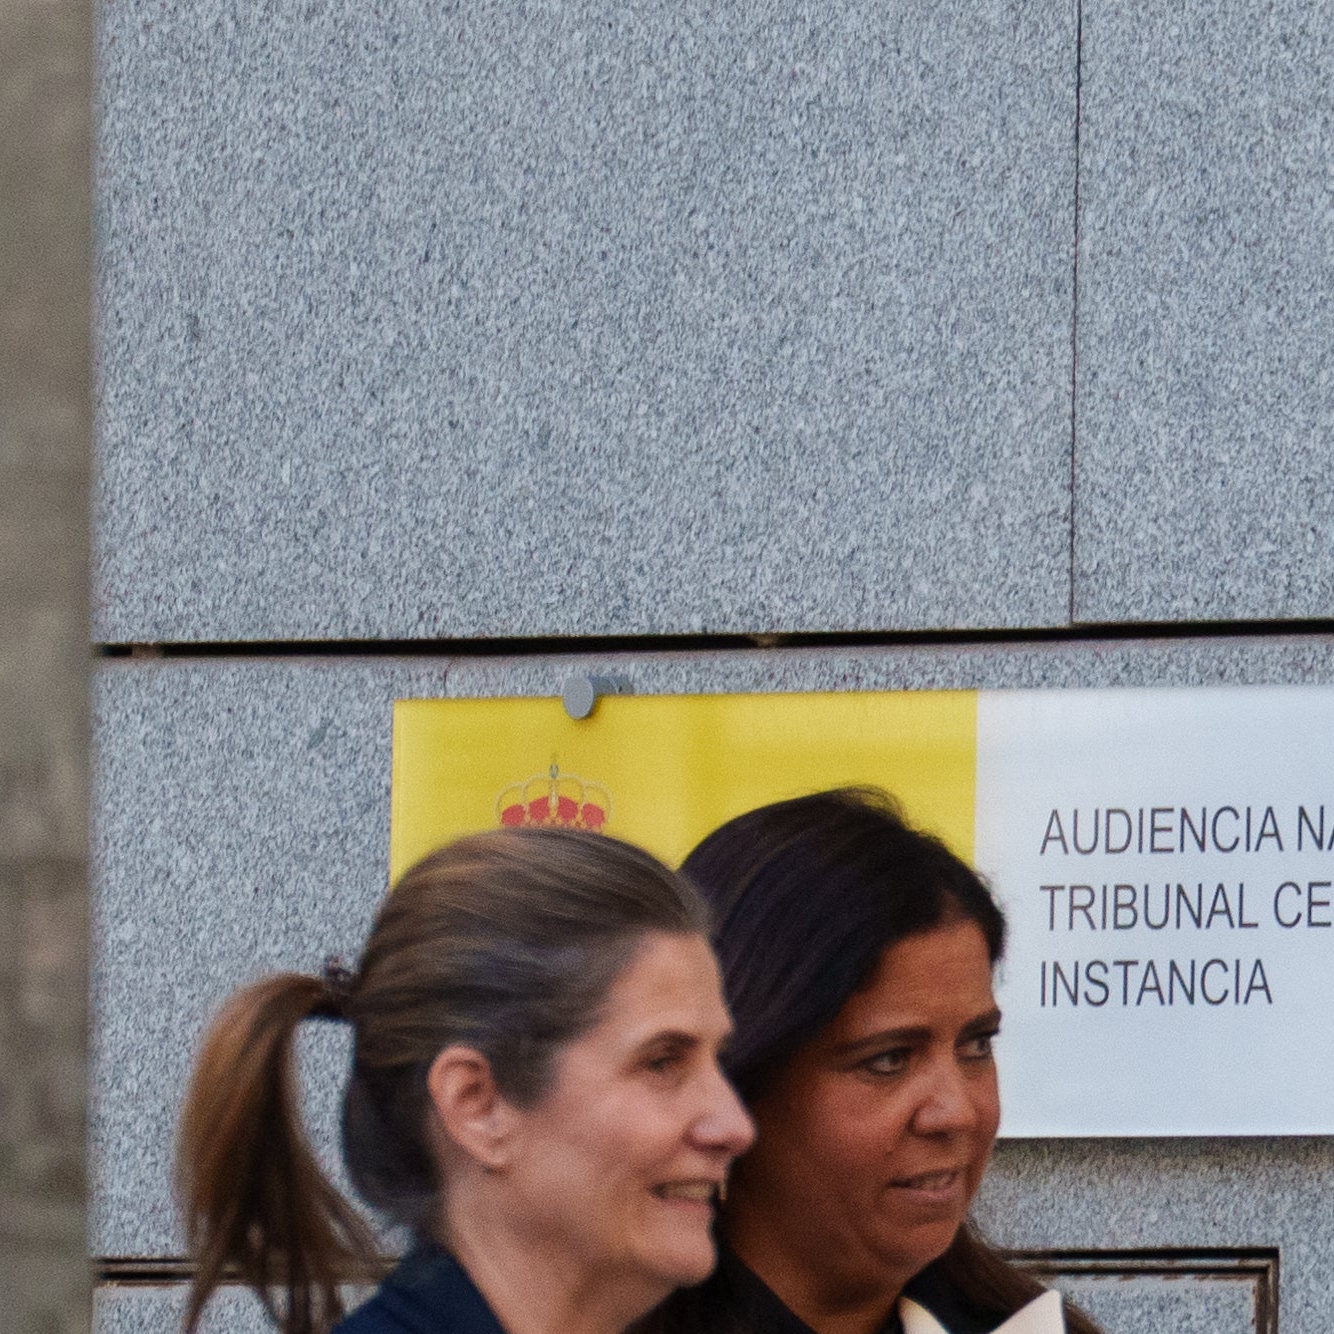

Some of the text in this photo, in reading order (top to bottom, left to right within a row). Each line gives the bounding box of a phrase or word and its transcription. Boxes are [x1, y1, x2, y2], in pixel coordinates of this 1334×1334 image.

[1039, 805, 1284, 857] AUDIENCIA
[1039, 882, 1260, 933] TRIBUNAL
[1040, 958, 1274, 1009] INSTANCIA
